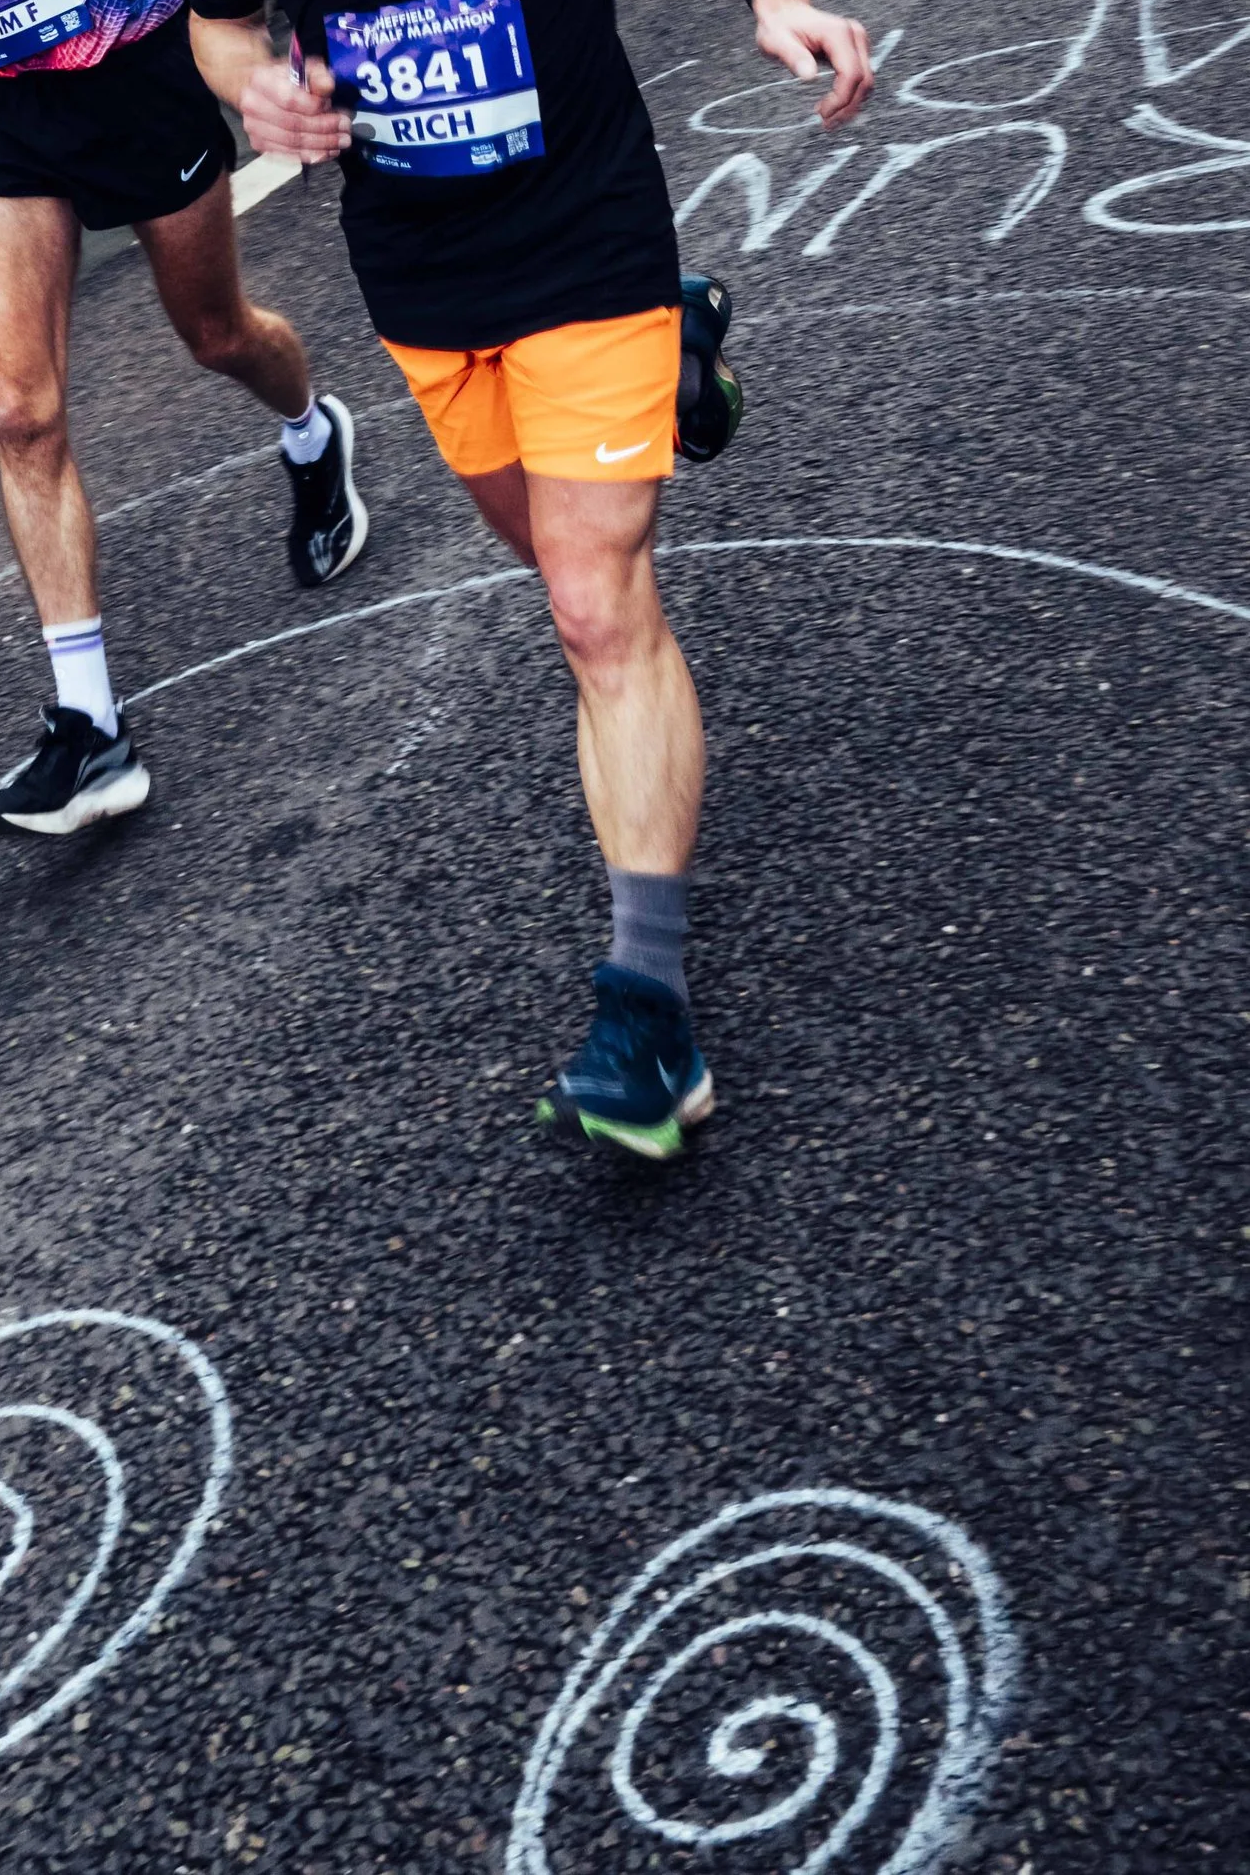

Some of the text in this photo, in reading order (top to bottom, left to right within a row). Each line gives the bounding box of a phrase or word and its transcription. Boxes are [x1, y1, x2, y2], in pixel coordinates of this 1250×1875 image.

[25, 1, 38, 22] F
[372, 9, 496, 45] HALF MARATHON
[356, 43, 489, 104] 3841
[391, 110, 476, 143] RICH
